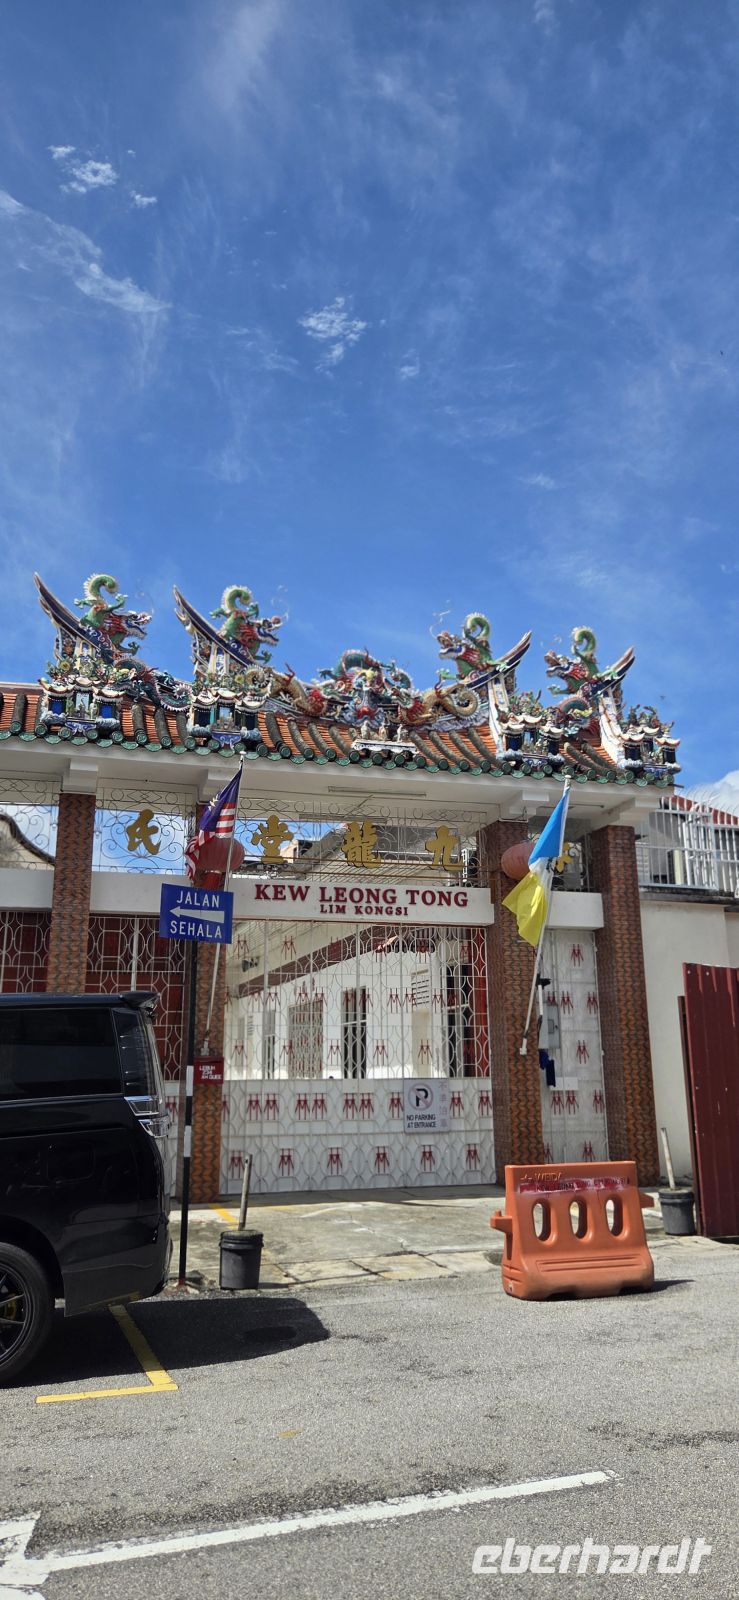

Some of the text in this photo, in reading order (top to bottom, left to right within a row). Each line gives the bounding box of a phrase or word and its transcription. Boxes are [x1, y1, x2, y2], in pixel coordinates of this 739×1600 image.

[176, 890, 220, 909] JALAN
[254, 884, 469, 907] KEW LEONG TONG
[320, 904, 409, 916] LIM KONGSI
[170, 920, 222, 939] SEHALA
[407, 1121, 413, 1129] AT
